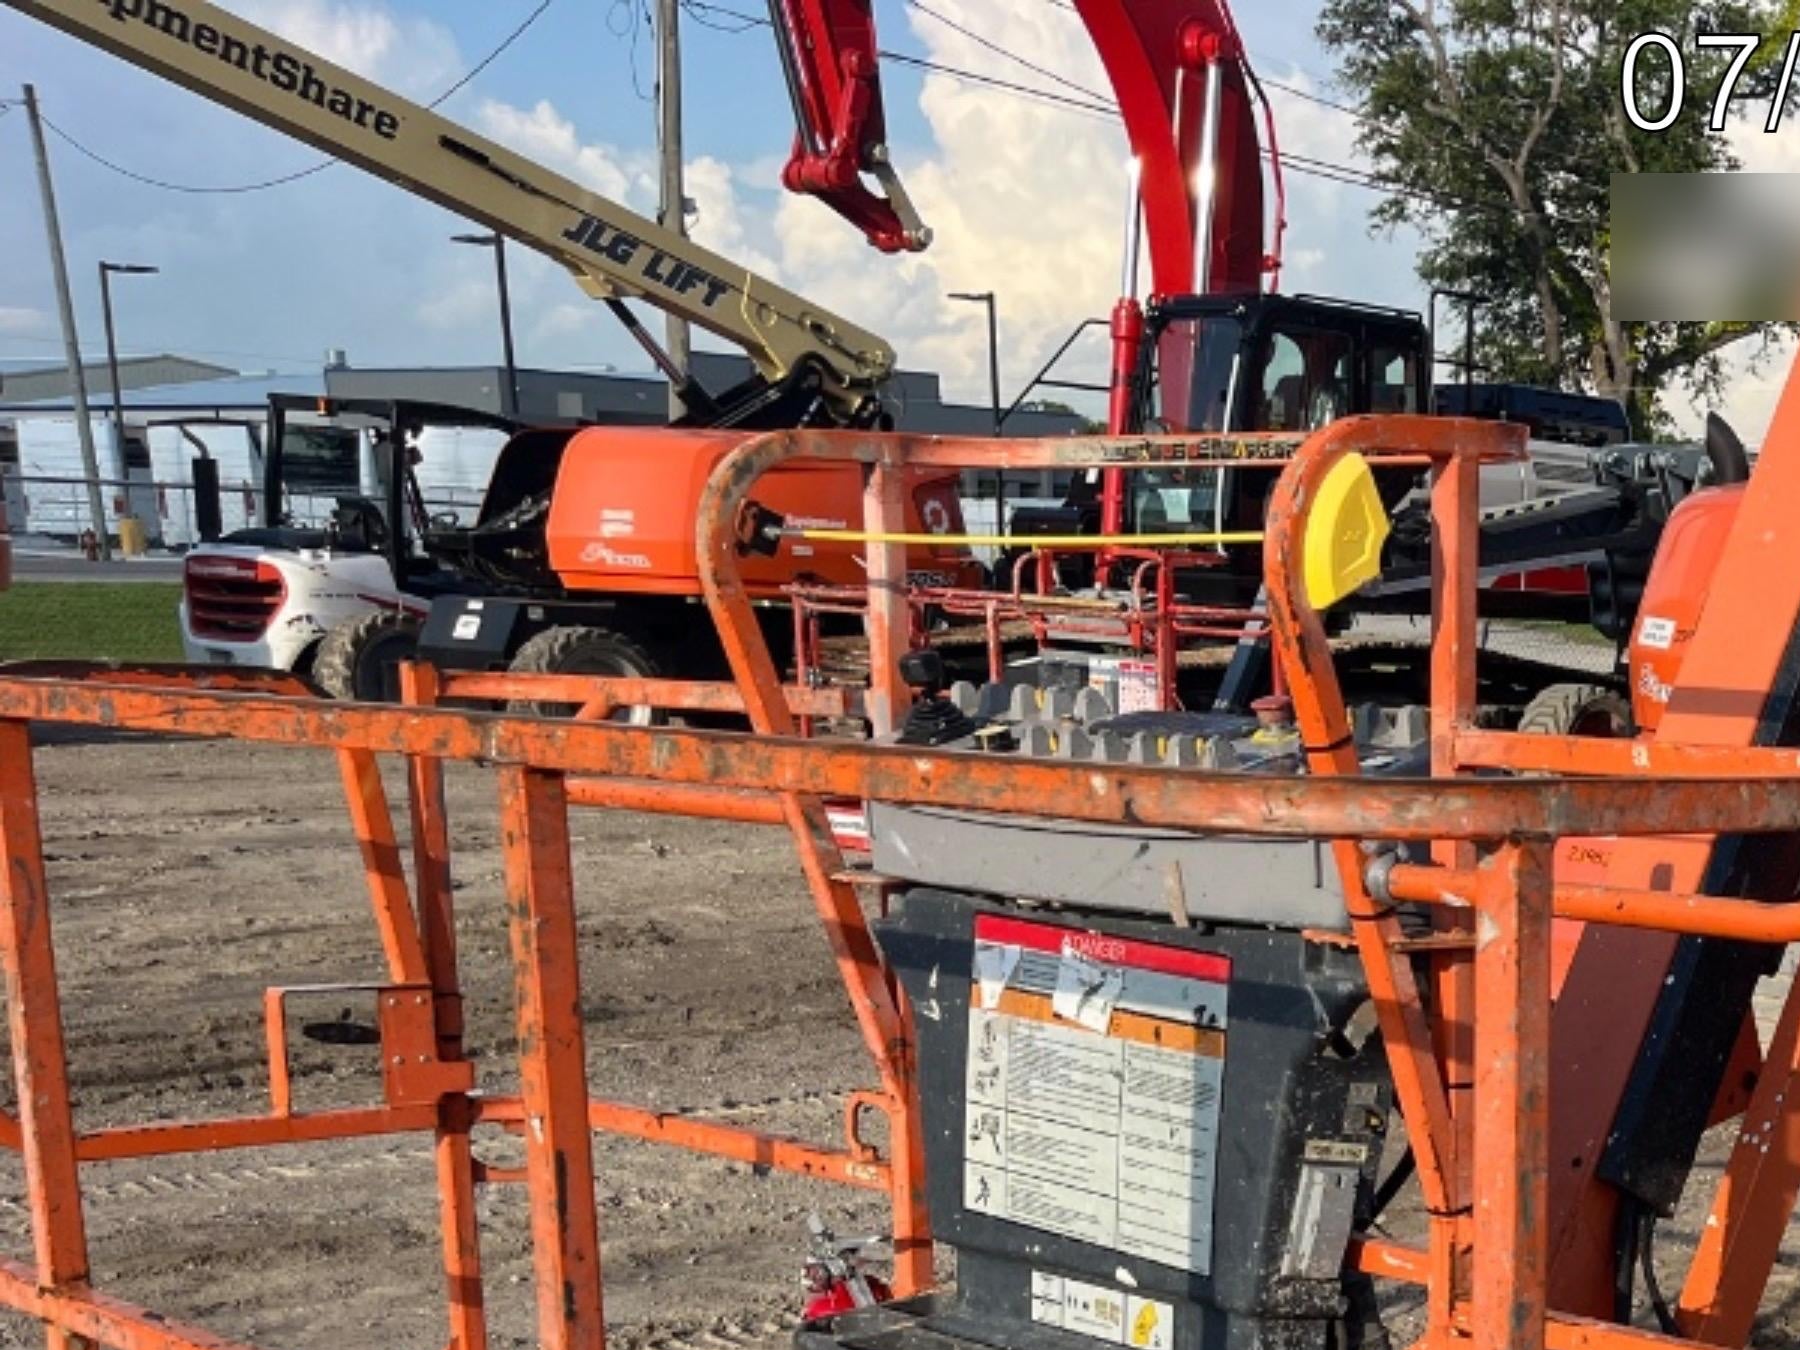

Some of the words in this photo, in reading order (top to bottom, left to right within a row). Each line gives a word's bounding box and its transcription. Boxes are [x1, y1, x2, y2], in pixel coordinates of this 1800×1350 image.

[97, 0, 401, 139] pmentShare
[561, 214, 641, 265] JLG
[641, 249, 730, 307] LIFT
